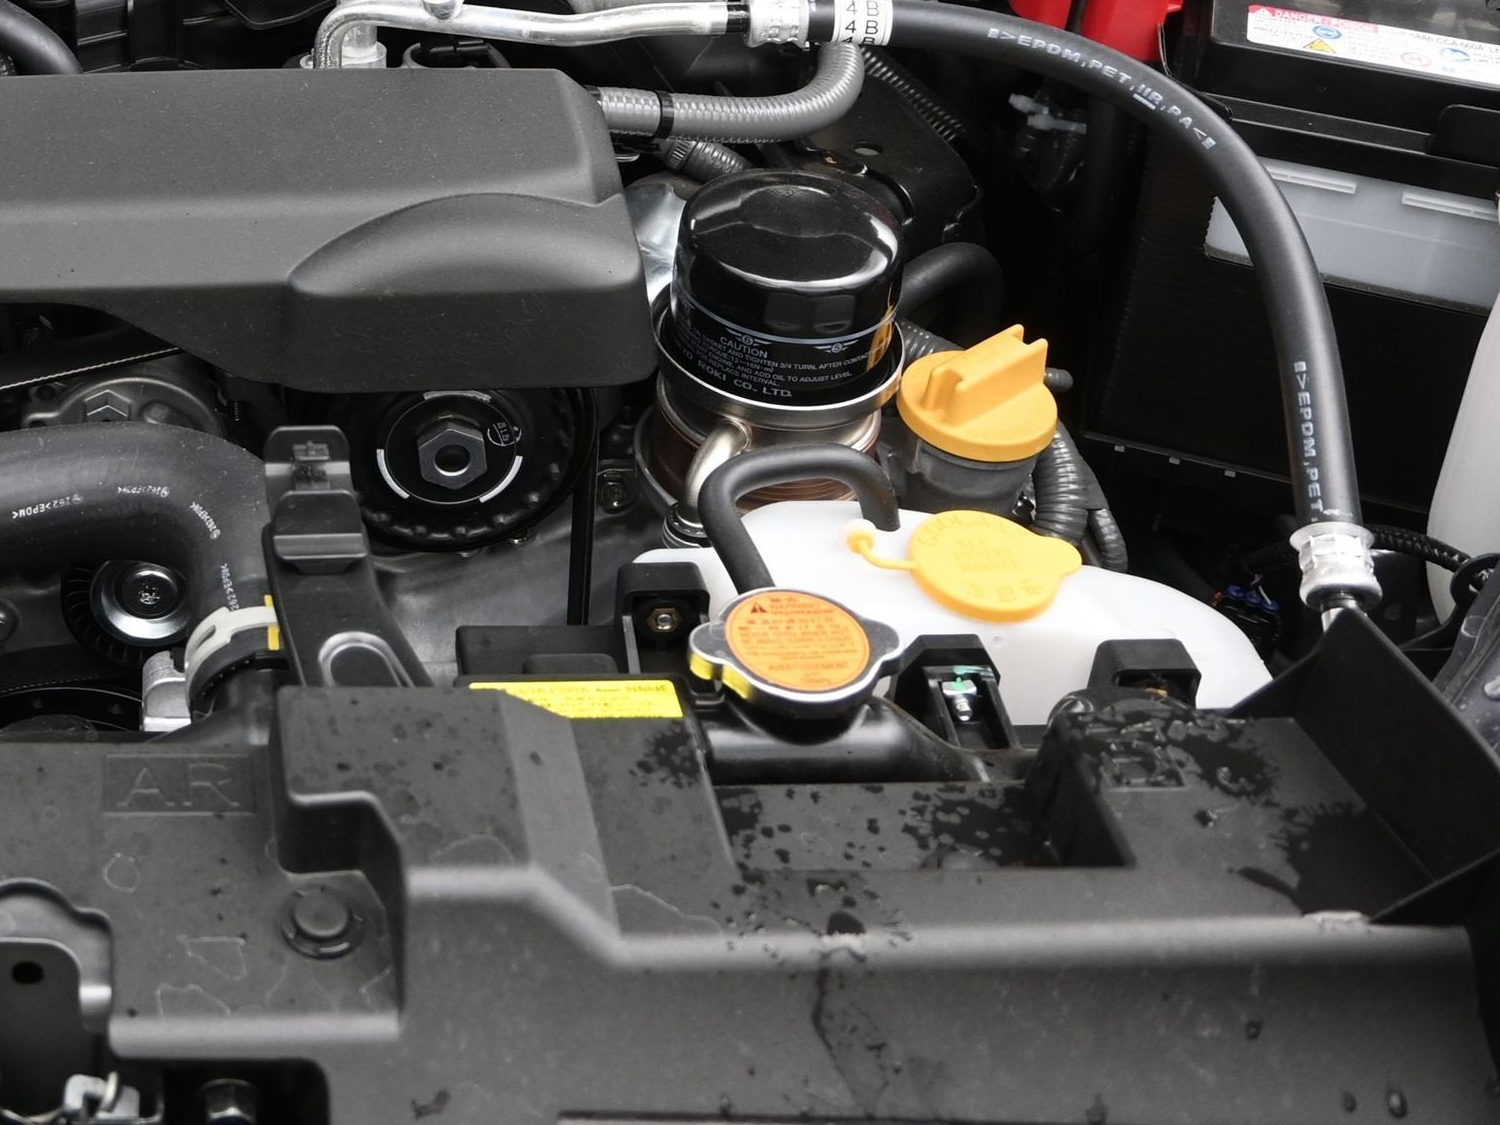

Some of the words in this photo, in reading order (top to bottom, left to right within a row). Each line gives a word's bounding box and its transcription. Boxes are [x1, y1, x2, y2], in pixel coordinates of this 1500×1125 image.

[846, 0, 858, 15] 4
[866, 0, 880, 16] B
[845, 20, 857, 34] 4
[865, 20, 879, 35] B
[719, 336, 768, 359] CAUTION
[696, 358, 727, 382] ROKI
[745, 354, 779, 368] TIGHTEN
[818, 361, 842, 371] AFTER
[754, 369, 771, 380] ADD
[772, 374, 786, 382] OIL
[787, 374, 799, 383] TO
[799, 373, 831, 383] ADJUST
